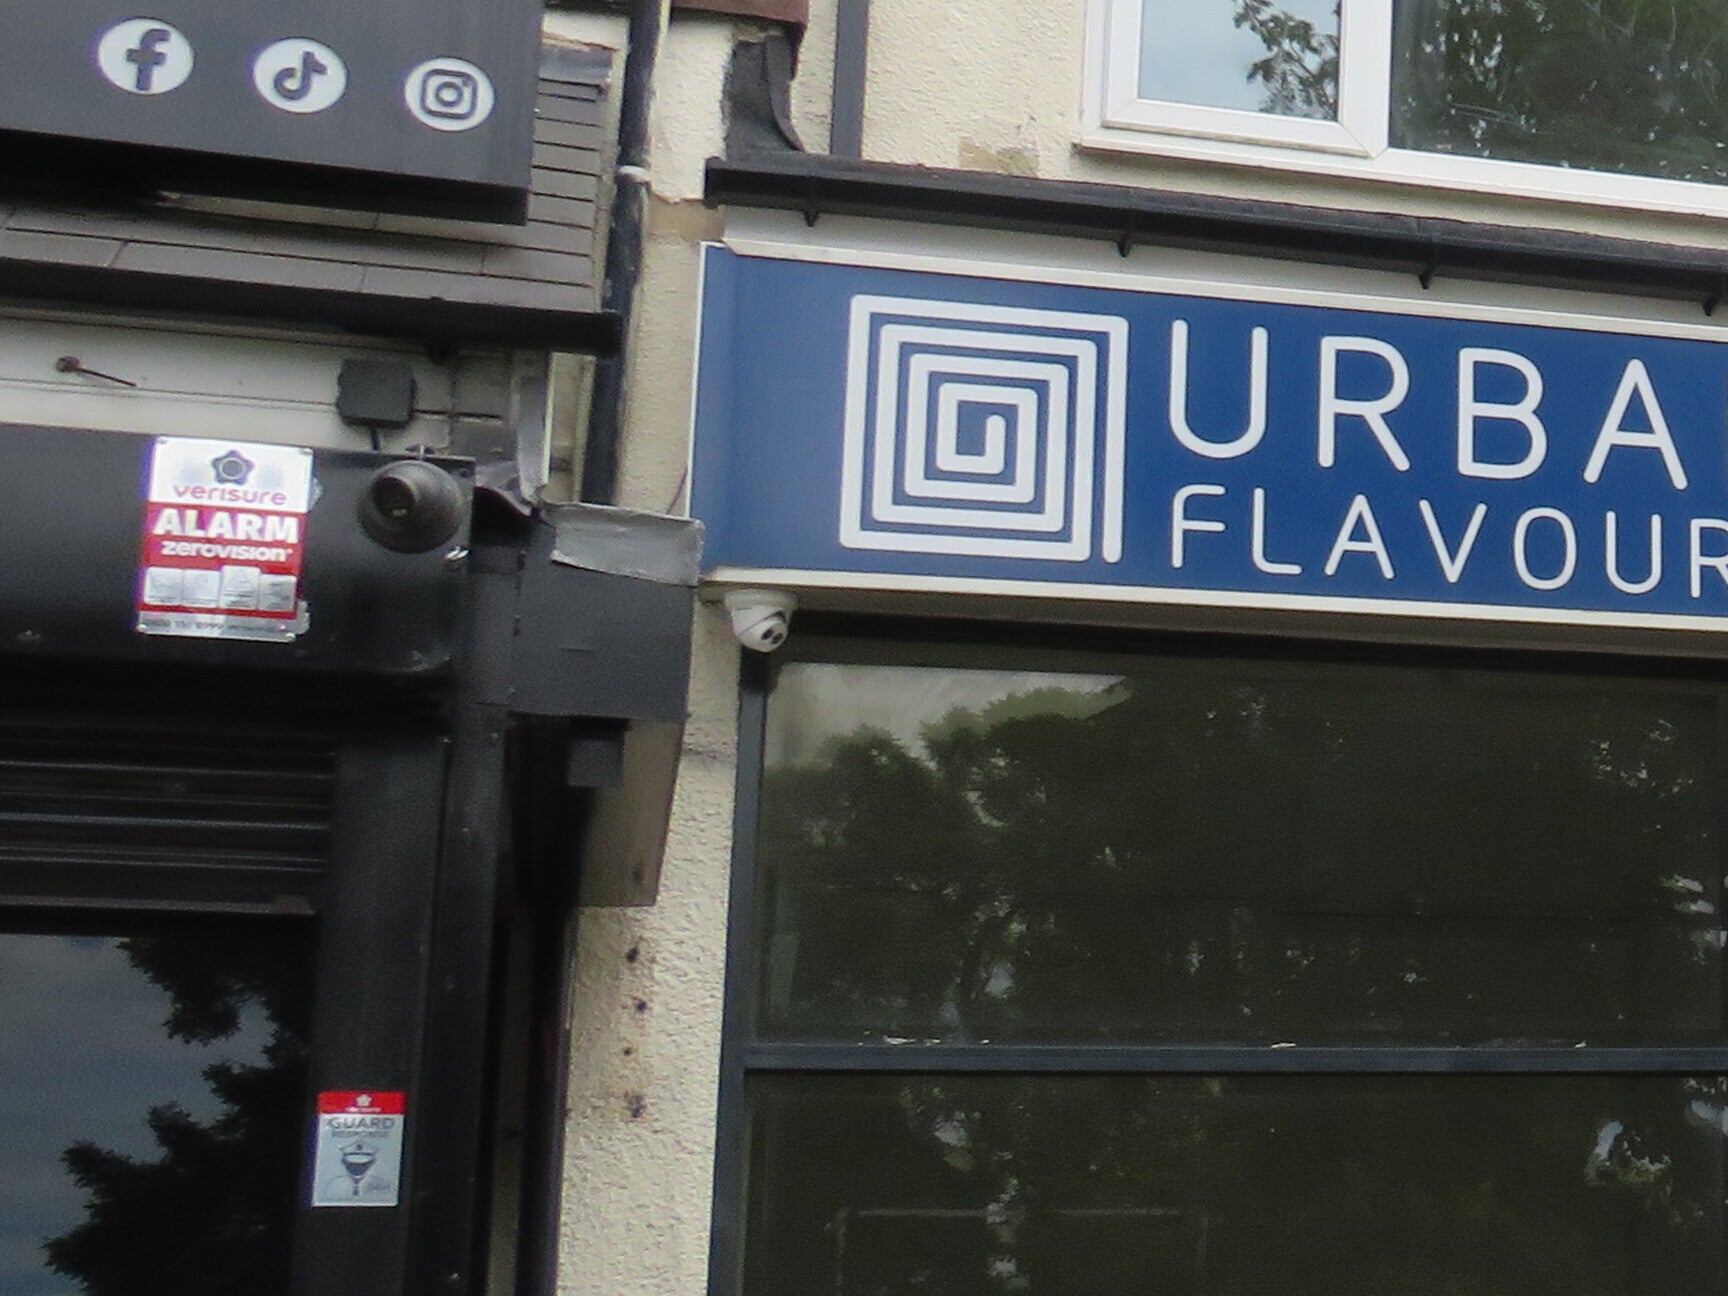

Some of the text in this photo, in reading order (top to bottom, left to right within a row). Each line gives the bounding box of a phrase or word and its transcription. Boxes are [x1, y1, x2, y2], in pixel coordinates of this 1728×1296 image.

[173, 484, 288, 506] verisure
[152, 507, 300, 544] ALARM
[326, 1116, 396, 1130] GUARD
